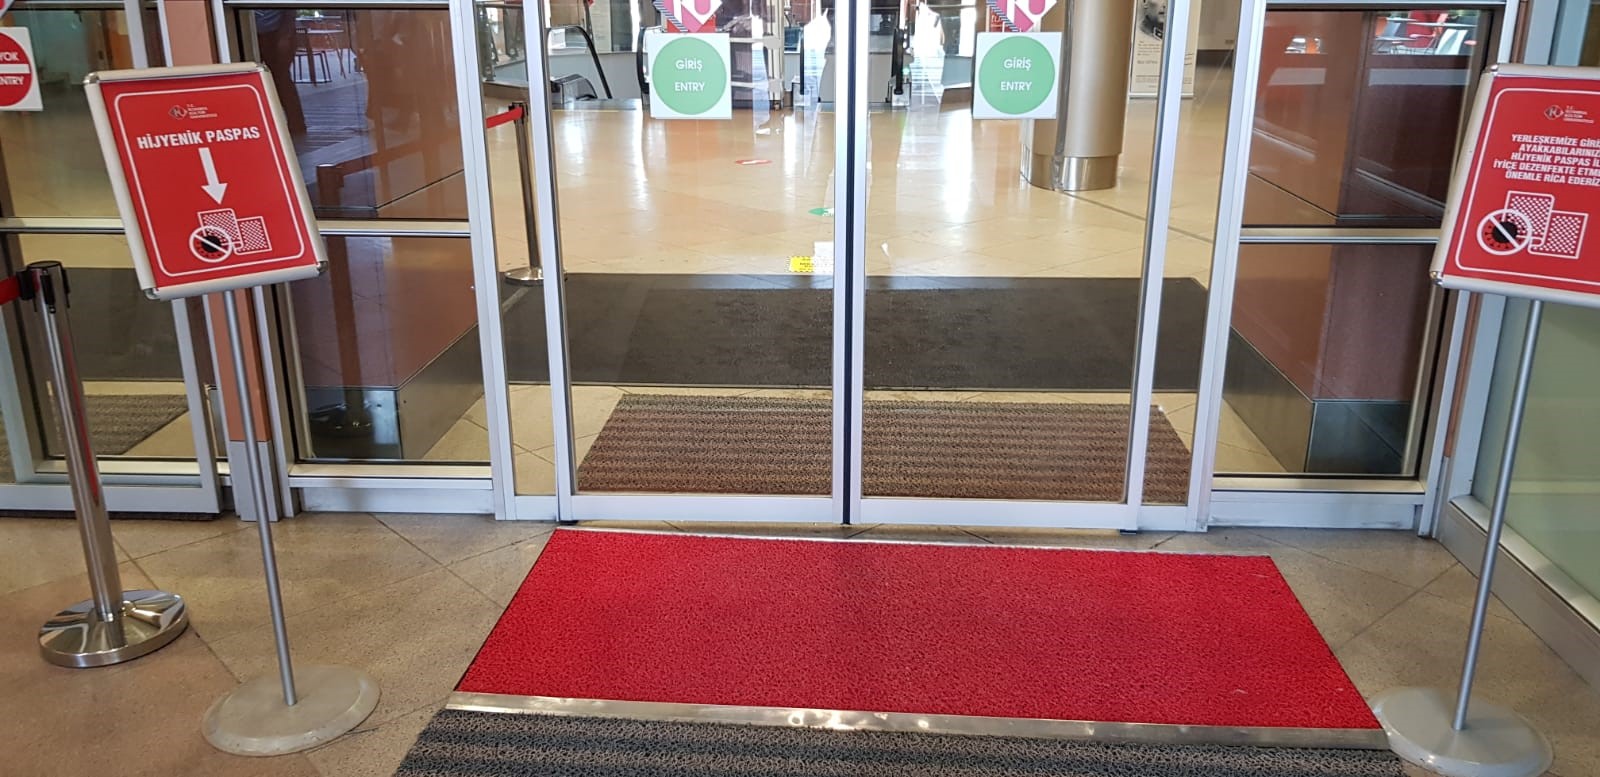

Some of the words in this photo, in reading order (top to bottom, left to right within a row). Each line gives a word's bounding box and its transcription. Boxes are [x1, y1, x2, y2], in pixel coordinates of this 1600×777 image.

[675, 58, 703, 72] GİRİŞ
[1003, 57, 1032, 71] GİRİŞ
[674, 82, 705, 92] ENTRY
[1000, 81, 1032, 91] ENTRY
[136, 130, 203, 149] HİJYENİK
[205, 126, 260, 143] PASPAS
[1511, 134, 1578, 147] YERLEŞKEMİZE
[1518, 161, 1576, 175] DEZENFEKTE
[1554, 155, 1591, 167] PASPAS
[1505, 169, 1542, 182] ÖNEMLE
[1543, 173, 1566, 183] RİCA
